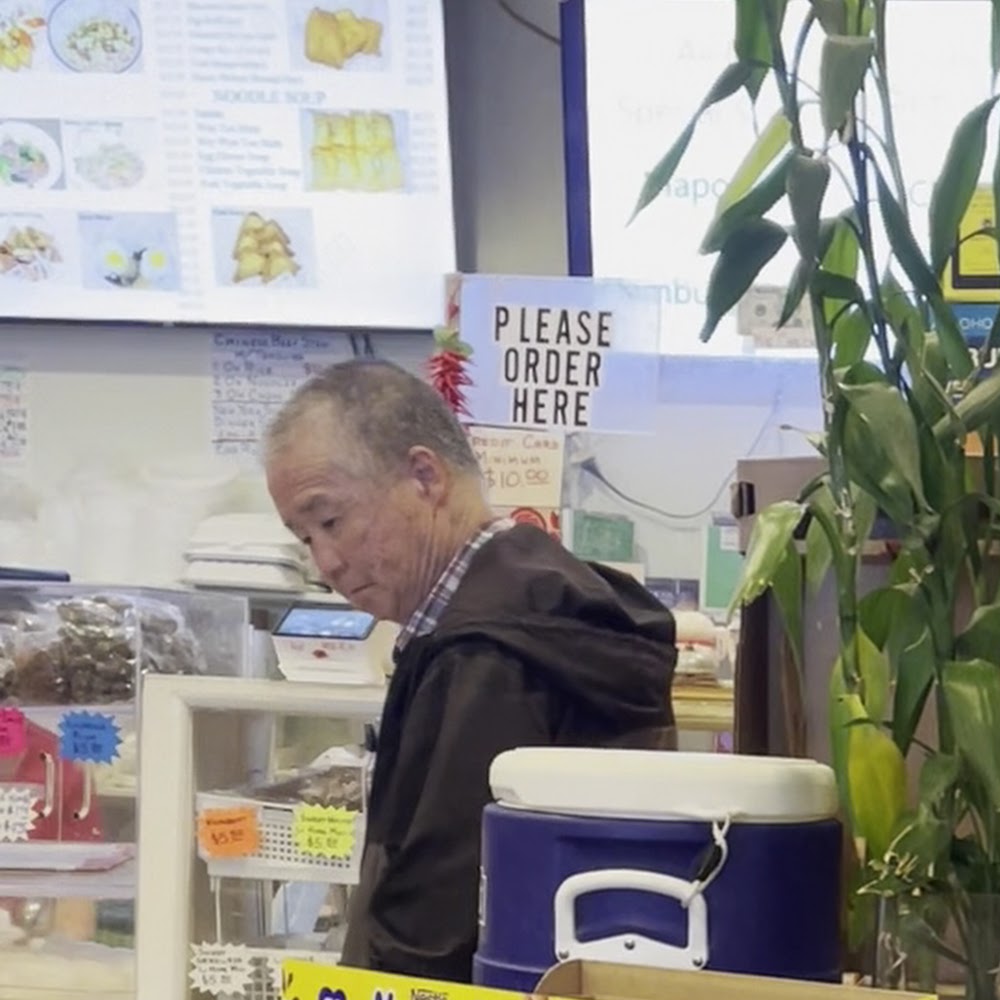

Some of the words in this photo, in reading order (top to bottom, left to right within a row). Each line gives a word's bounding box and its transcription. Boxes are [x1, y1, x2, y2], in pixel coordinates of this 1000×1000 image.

[495, 306, 613, 347] PLEASE
[504, 348, 602, 387] ORDER
[512, 388, 589, 426] HERE
